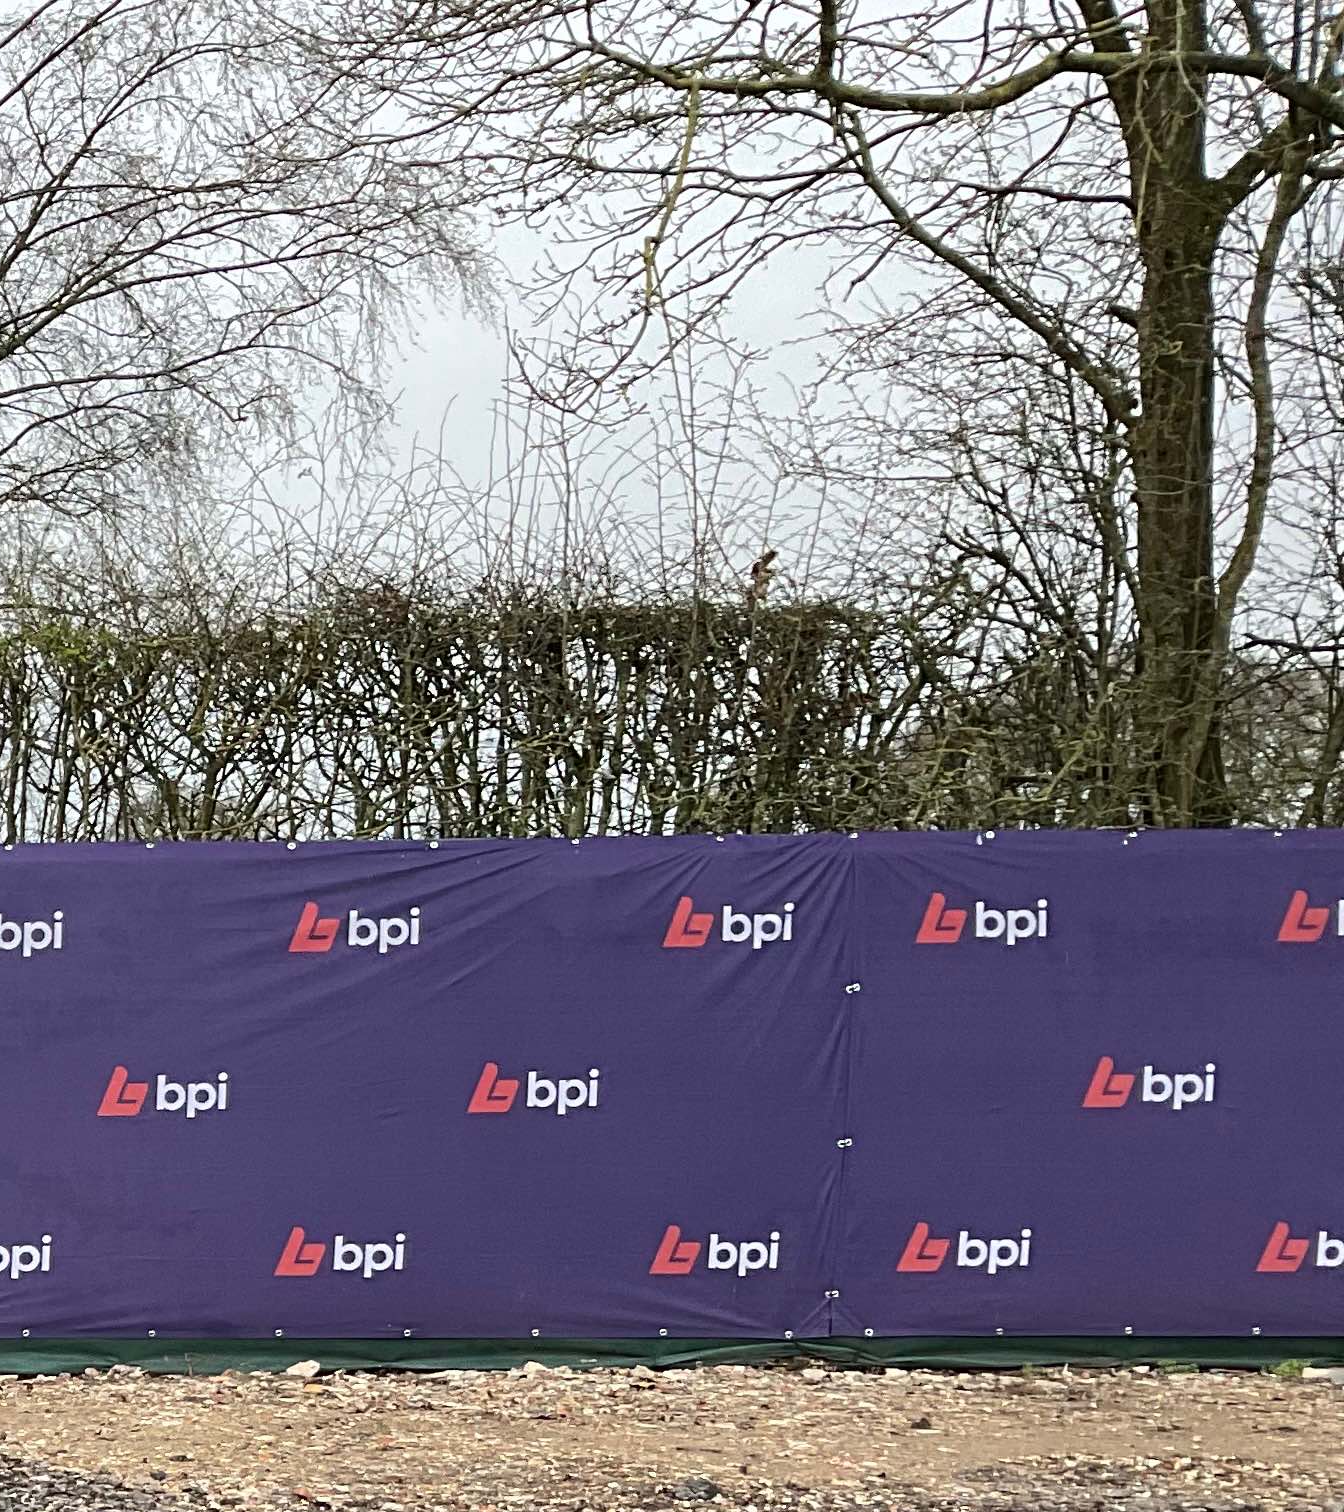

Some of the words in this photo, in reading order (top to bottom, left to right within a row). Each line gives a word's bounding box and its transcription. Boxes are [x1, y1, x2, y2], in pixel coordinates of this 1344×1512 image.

[348, 907, 421, 954] bpi
[722, 902, 795, 950] bpi
[975, 898, 1048, 946] bpi
[156, 1071, 229, 1118] bpi
[526, 1068, 600, 1115] bpi
[1142, 1062, 1216, 1110] bpi
[333, 1232, 406, 1278] bpi
[707, 1231, 780, 1277] bpi
[957, 1228, 1032, 1275] bpi
